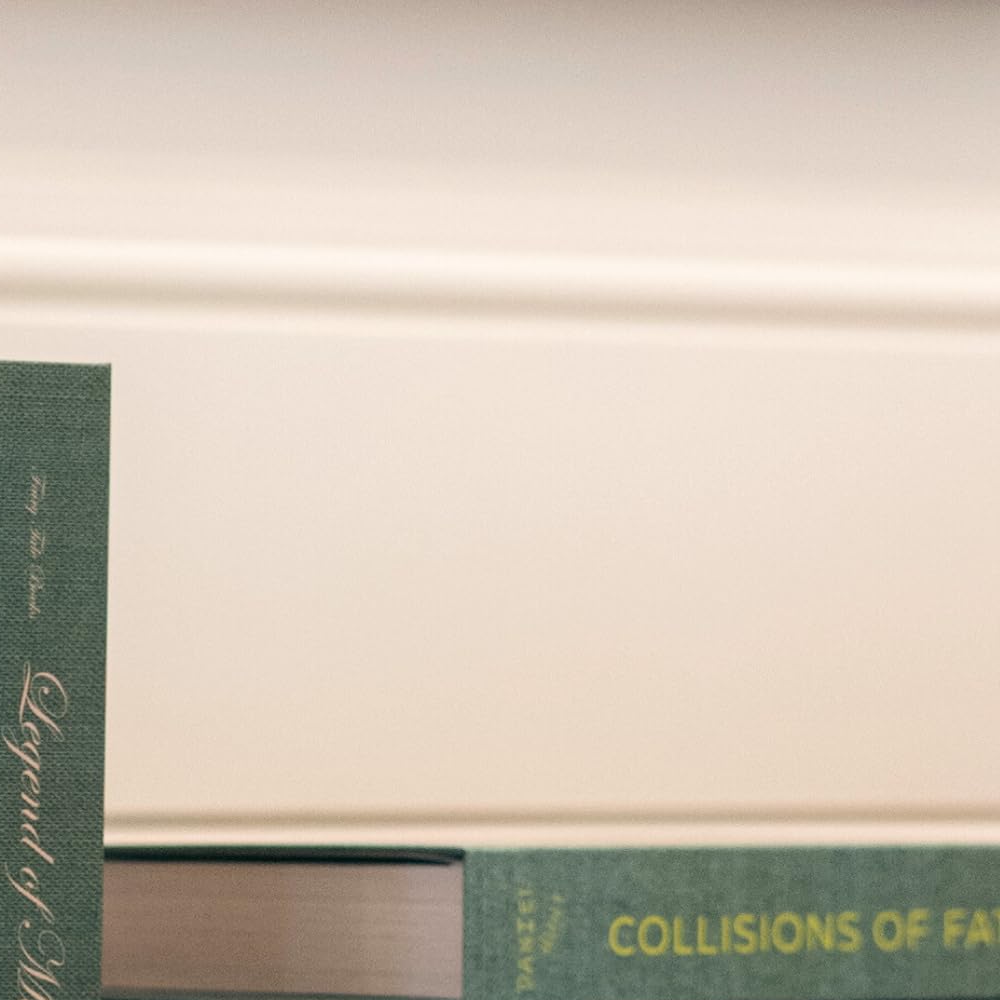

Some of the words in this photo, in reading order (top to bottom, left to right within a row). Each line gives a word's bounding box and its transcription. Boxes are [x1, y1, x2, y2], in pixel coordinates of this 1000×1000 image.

[3, 662, 68, 864] Legend
[4, 861, 55, 924] of
[607, 911, 863, 957] COLLISIONS
[872, 907, 930, 953] OF
